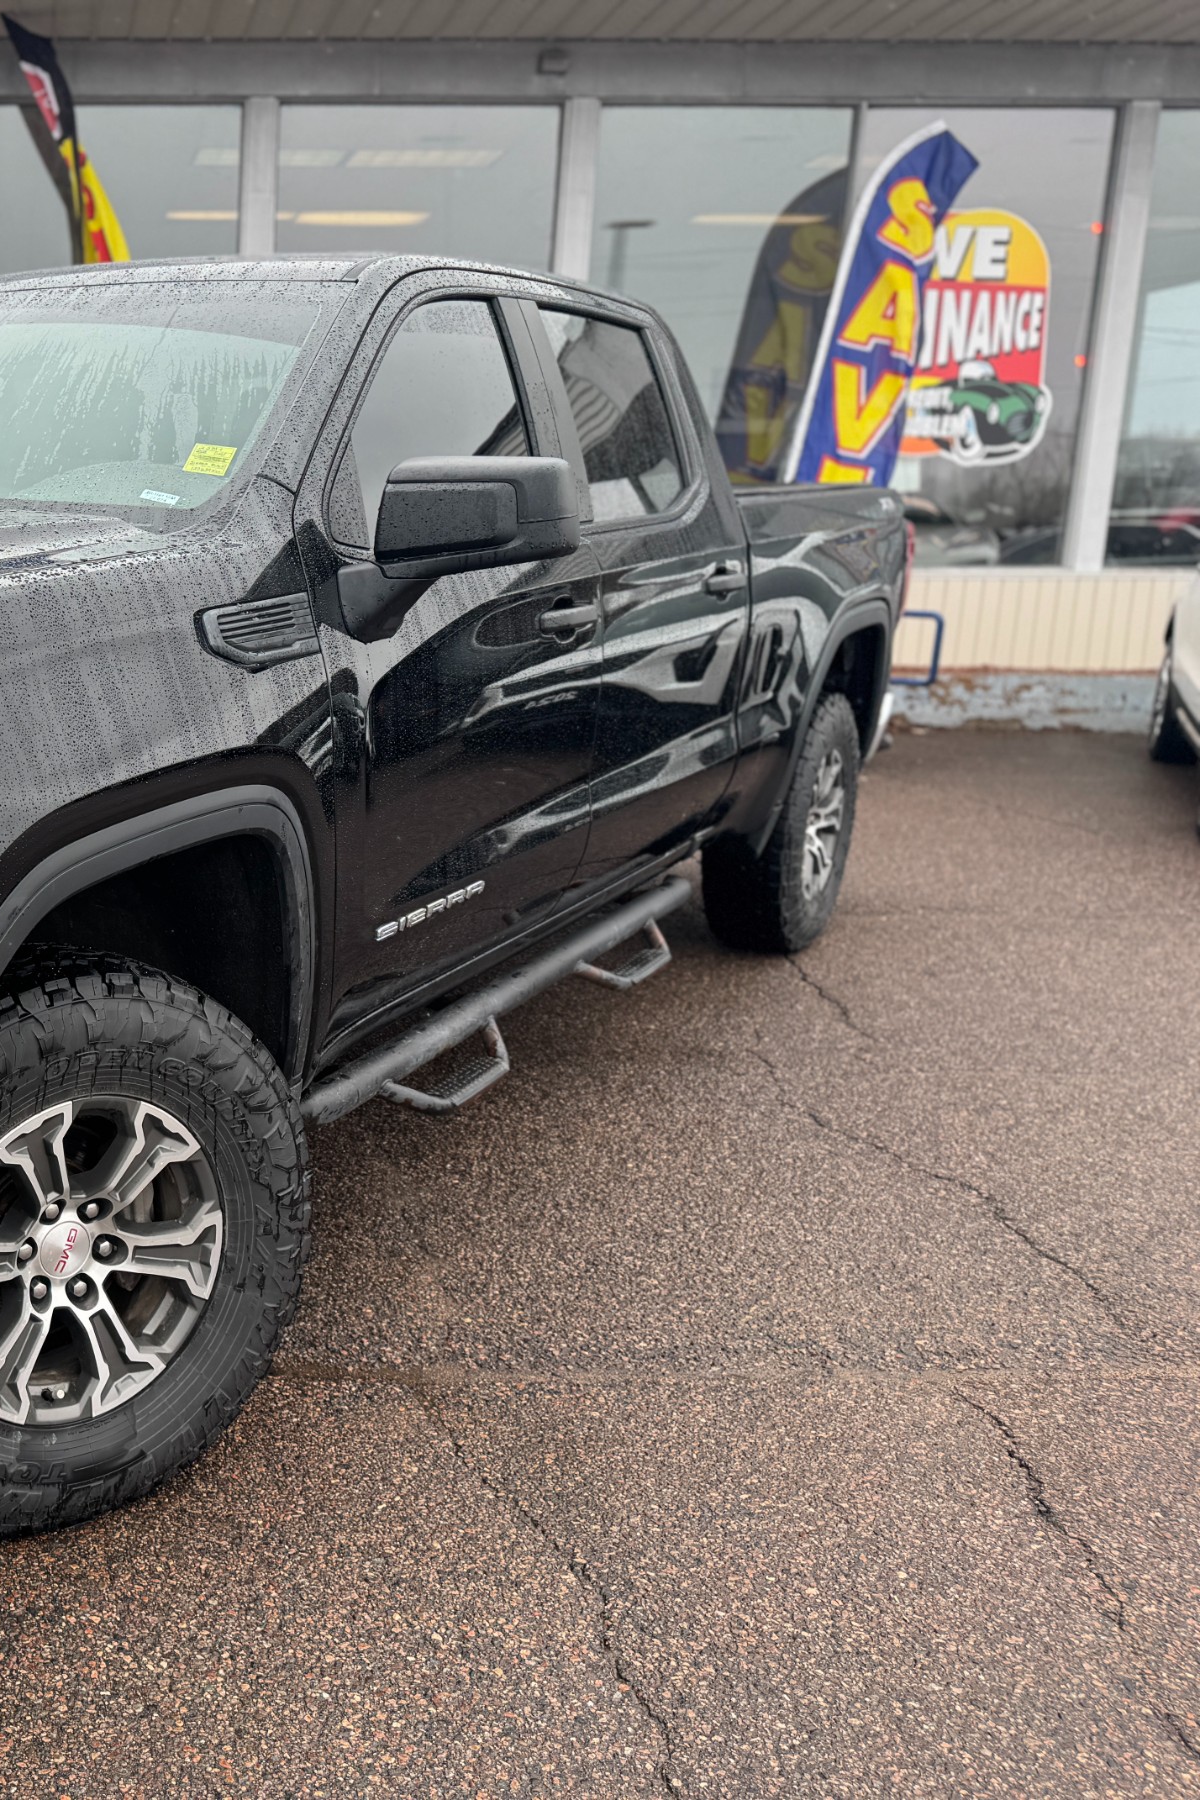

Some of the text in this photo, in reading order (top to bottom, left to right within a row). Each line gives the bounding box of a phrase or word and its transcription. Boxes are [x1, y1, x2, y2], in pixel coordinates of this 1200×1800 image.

[814, 176, 937, 486] SAV
[917, 288, 1045, 372] INANCE
[374, 879, 486, 942] SIERRA
[54, 1227, 79, 1275] GMC
